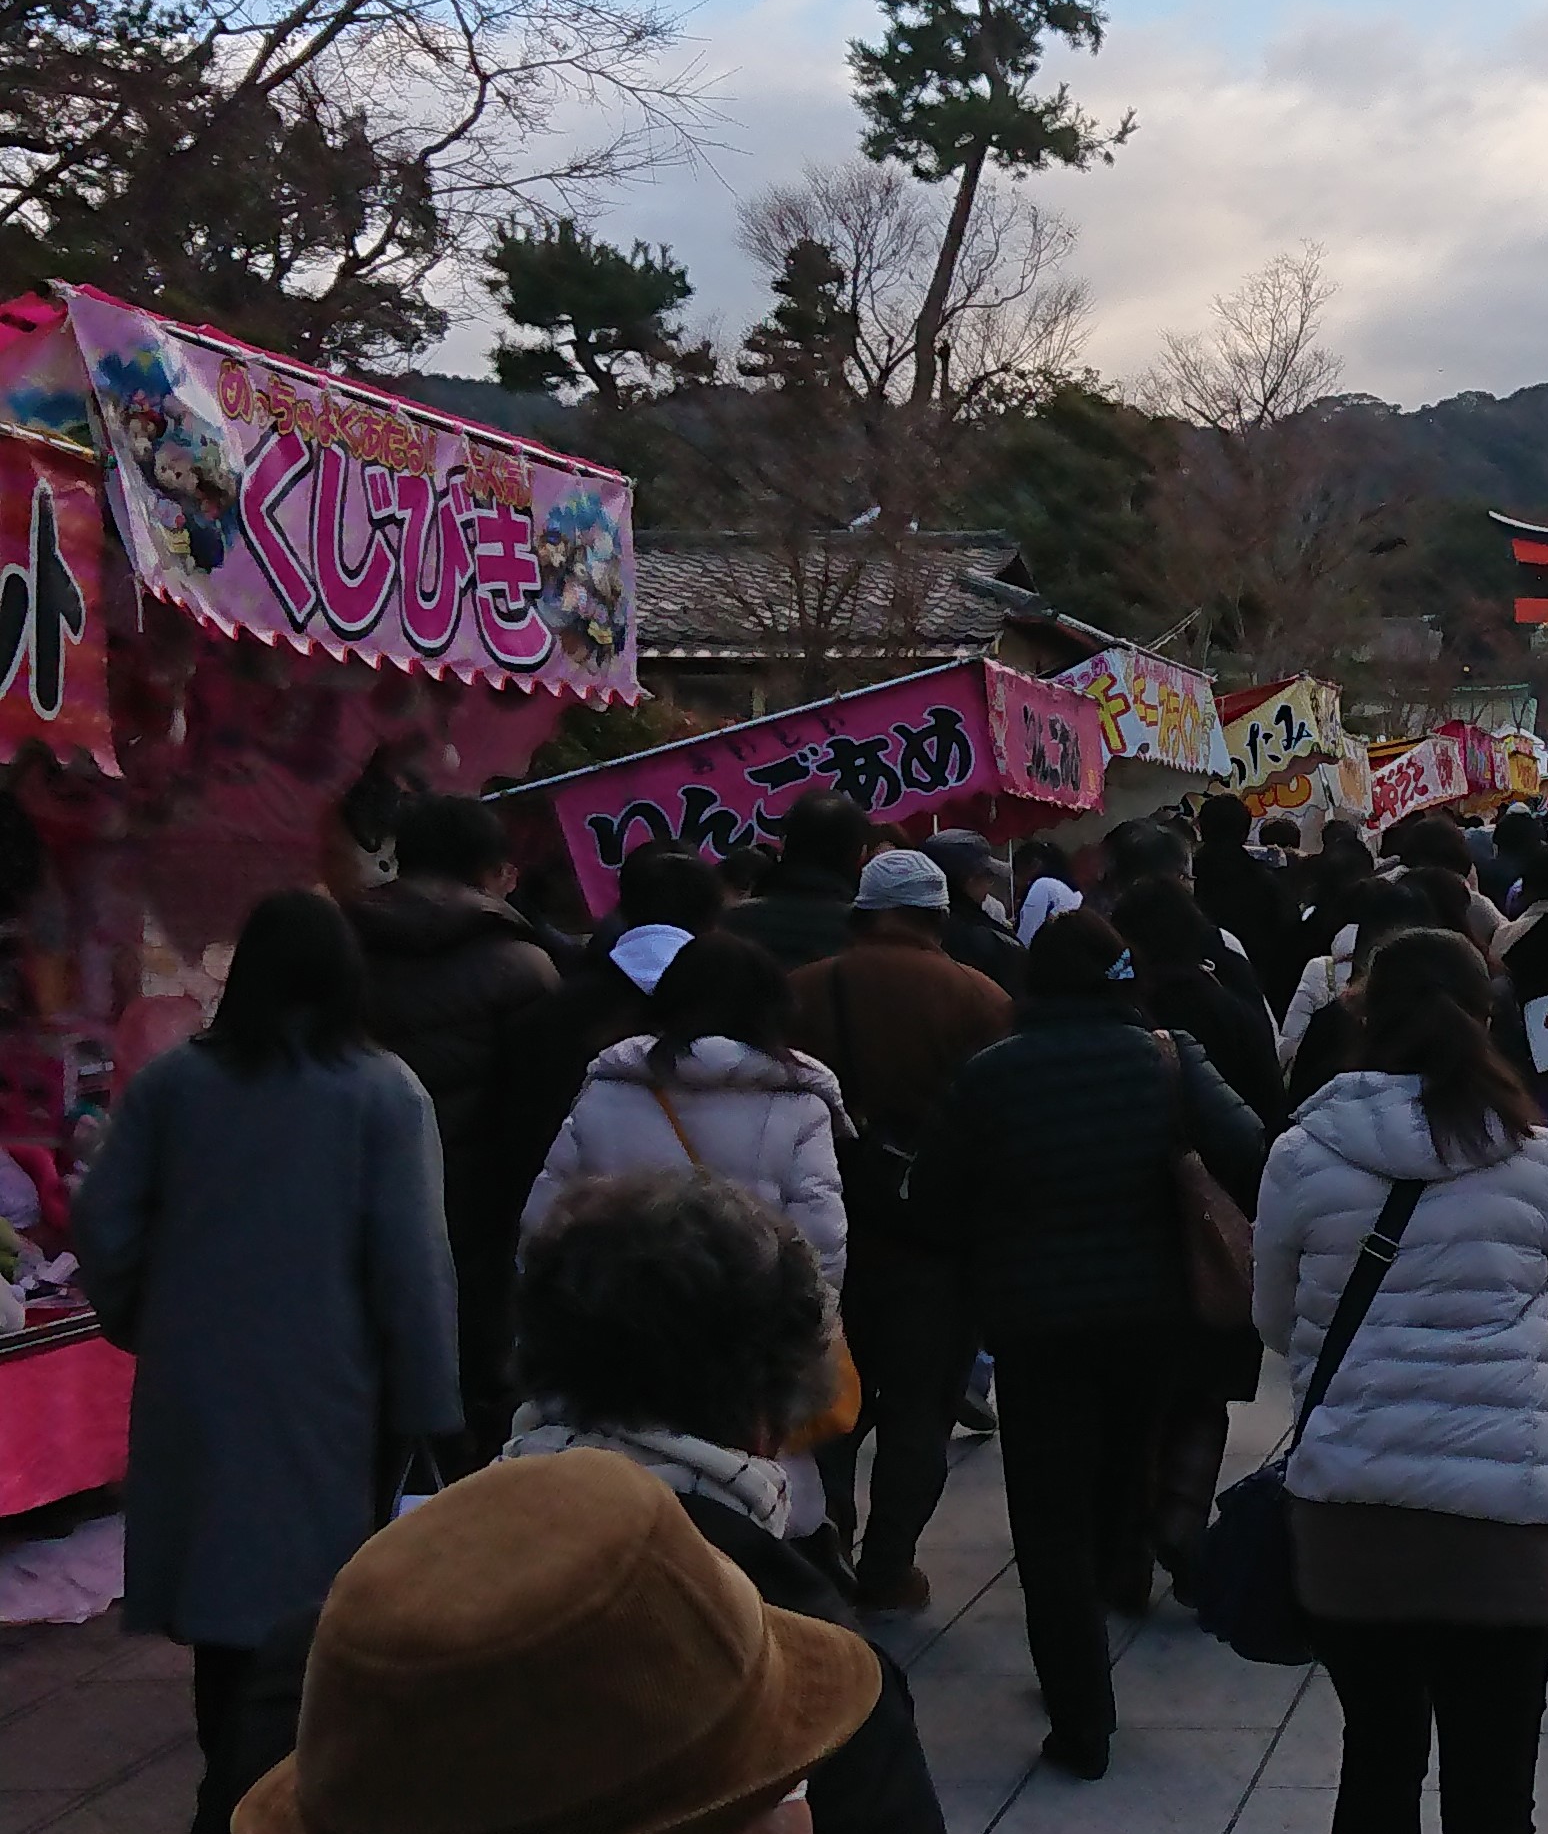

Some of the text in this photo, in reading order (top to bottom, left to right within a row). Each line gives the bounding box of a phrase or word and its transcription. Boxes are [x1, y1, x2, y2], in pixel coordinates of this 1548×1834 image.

[240, 429, 556, 672] くじびき
[584, 705, 976, 869] りんごあめ
